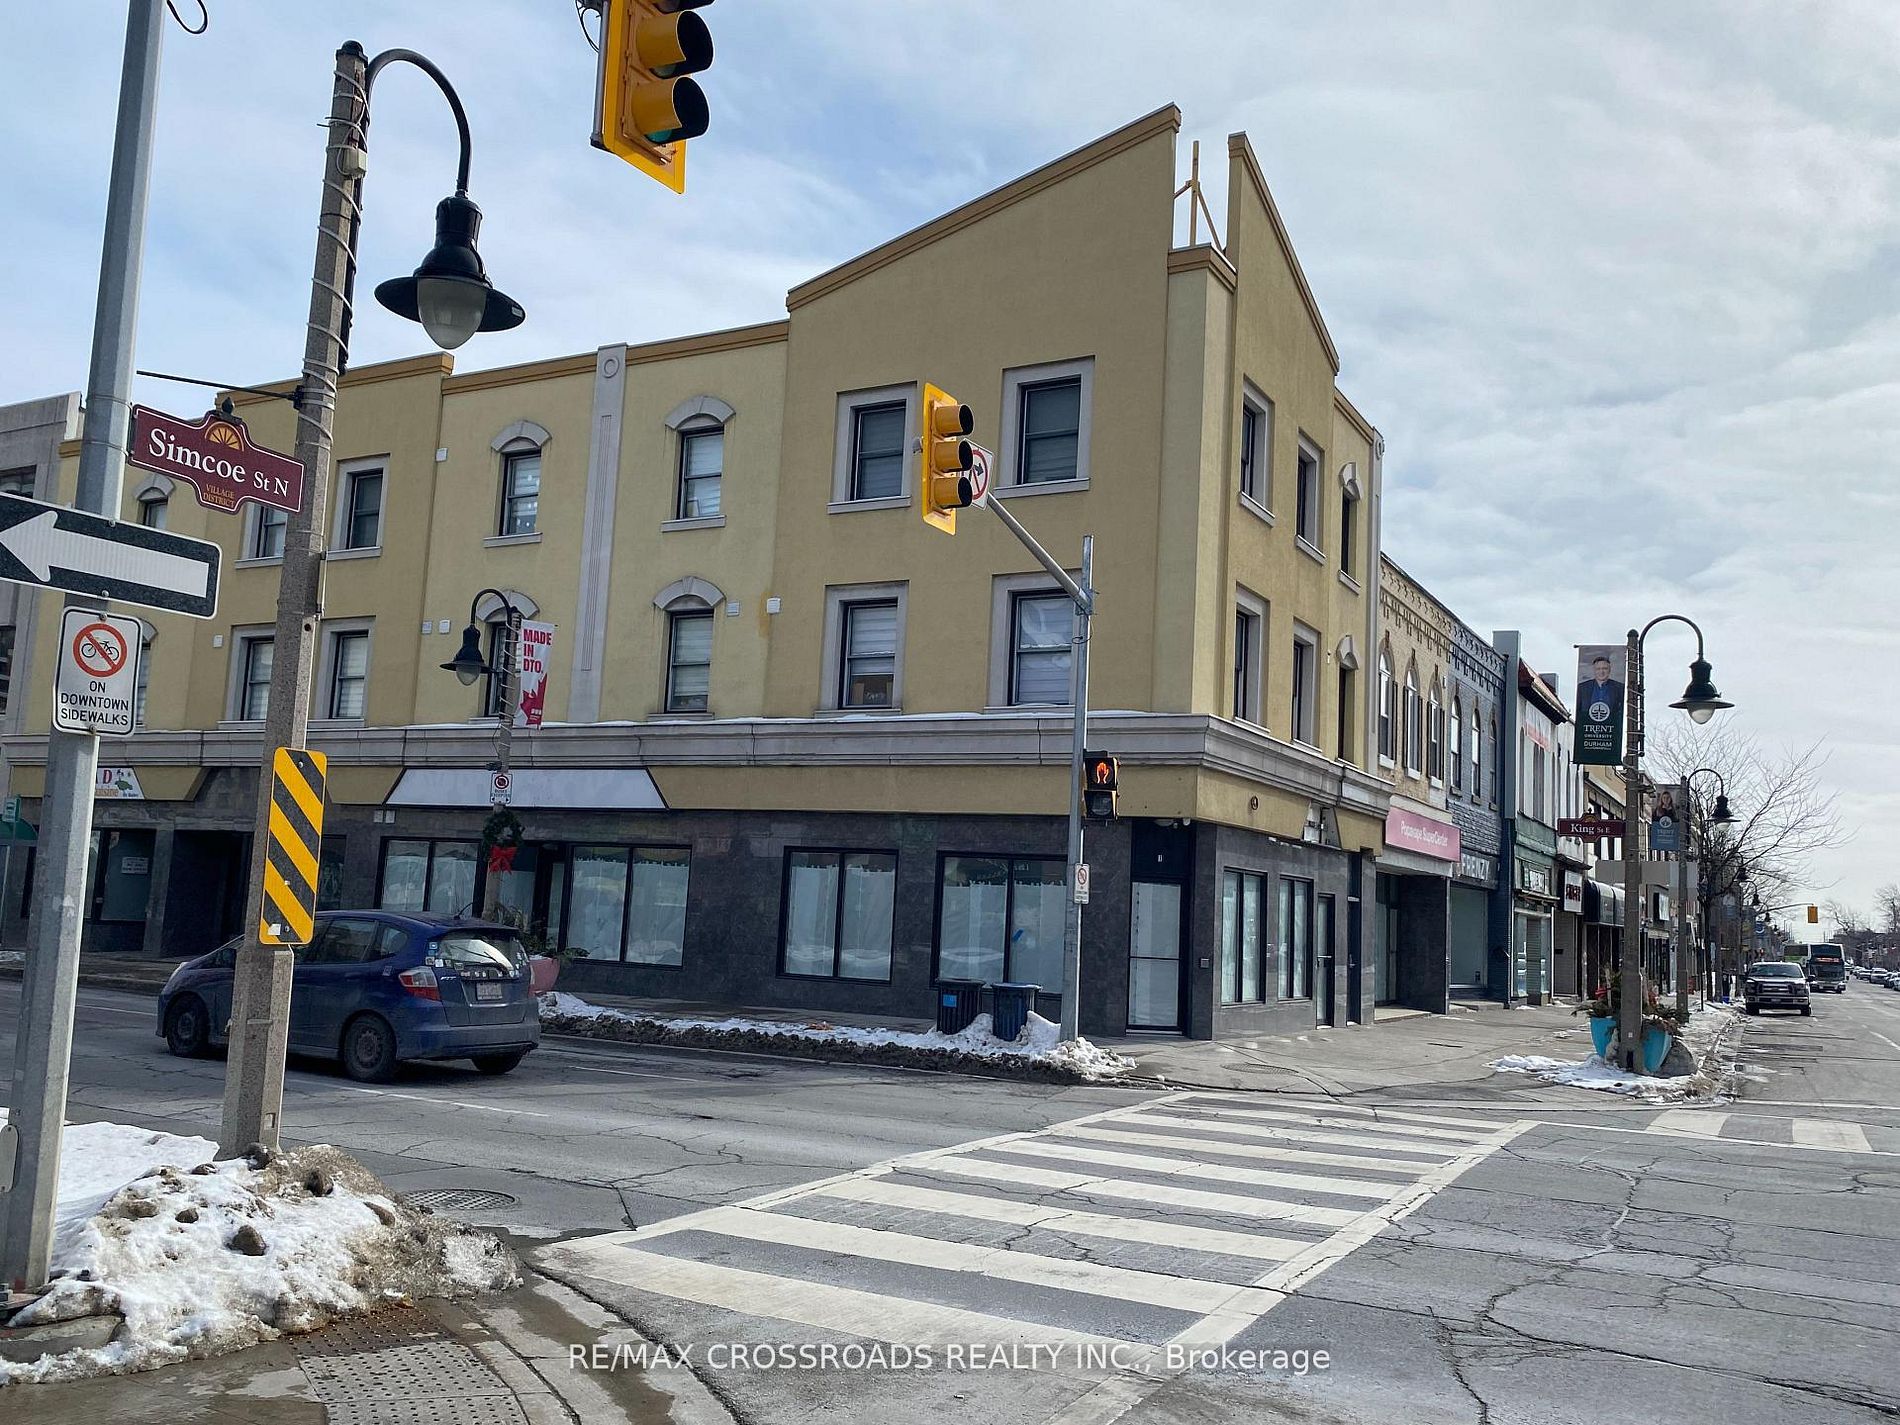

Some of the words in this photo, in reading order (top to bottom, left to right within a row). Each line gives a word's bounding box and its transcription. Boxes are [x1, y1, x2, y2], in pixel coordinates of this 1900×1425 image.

[149, 428, 246, 483] Simcoe
[253, 471, 270, 492] St
[273, 477, 289, 497] N
[205, 483, 236, 500] VILLAGE
[203, 492, 236, 508] DISTRICT
[523, 628, 552, 646] MADE
[523, 643, 534, 658] IN
[523, 658, 544, 674] DTO.
[89, 680, 106, 694] ON
[60, 692, 129, 711] DOWNTOWN
[60, 708, 129, 726] SIDEWALKS
[1583, 724, 1615, 734] TRENT
[1583, 740, 1613, 748] DURHAM
[1570, 823, 1596, 835] King
[1461, 853, 1490, 881] FRENZY
